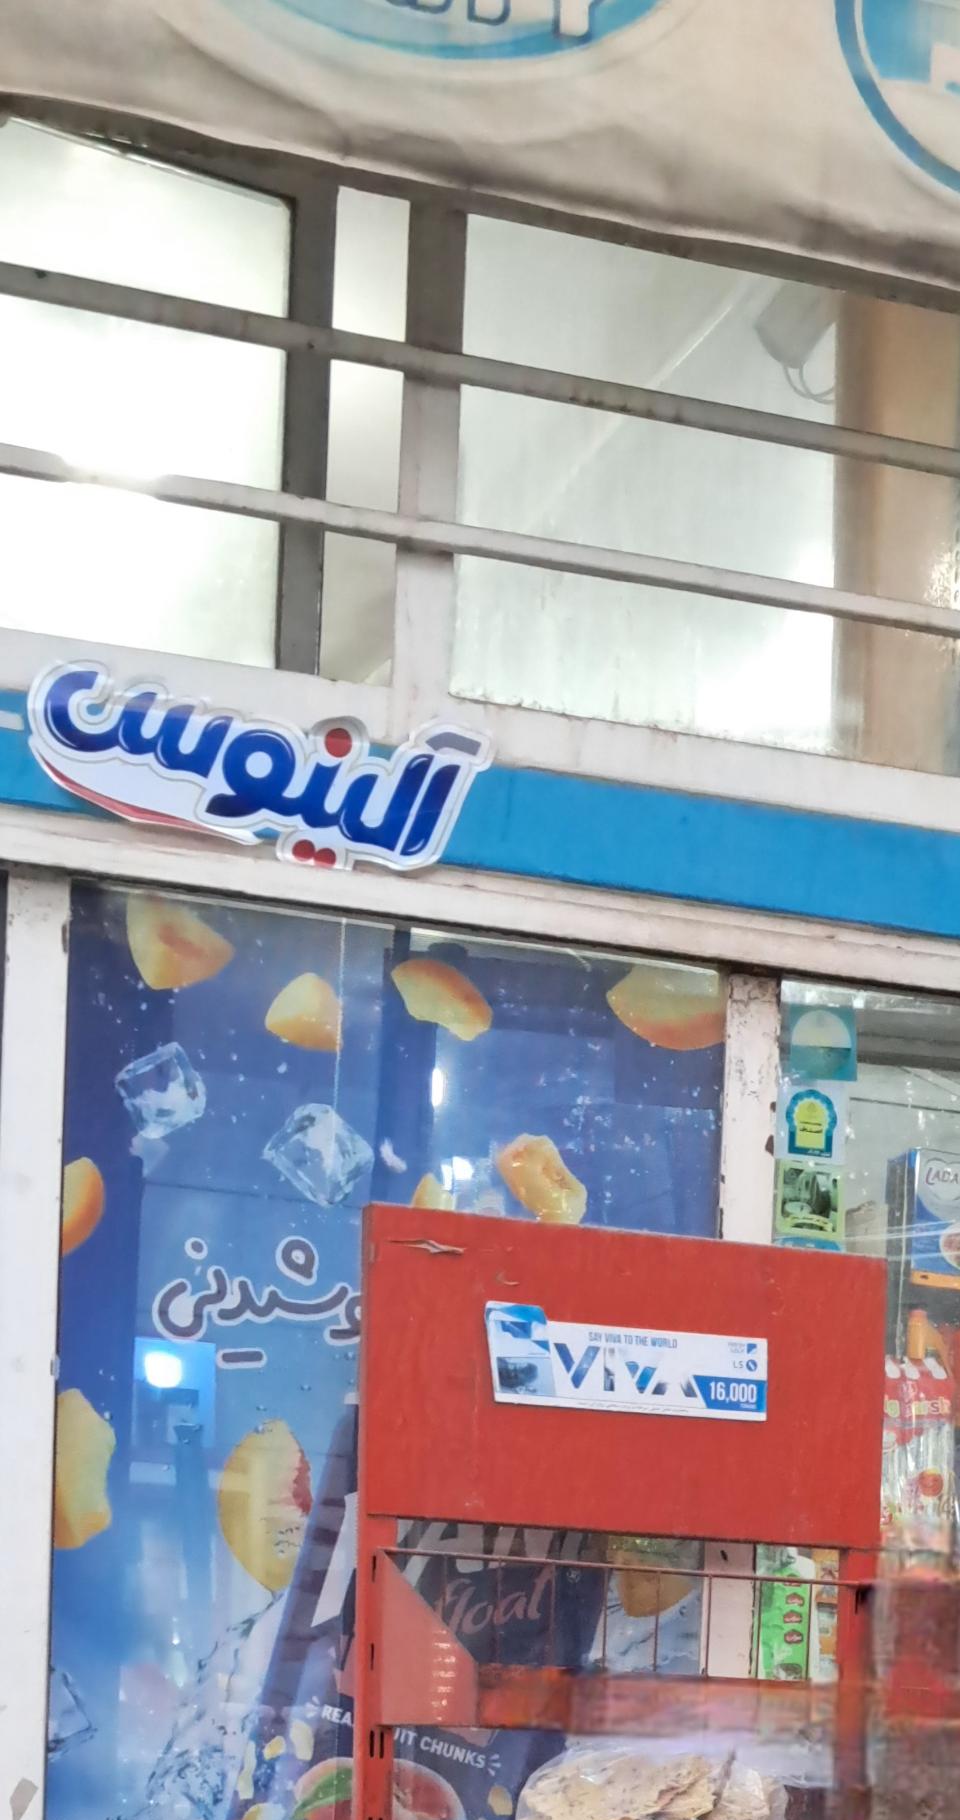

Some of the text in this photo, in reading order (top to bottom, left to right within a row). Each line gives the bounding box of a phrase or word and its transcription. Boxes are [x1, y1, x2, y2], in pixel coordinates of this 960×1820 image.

[588, 1331, 678, 1349] SAY VIVA TO THE WORLD
[709, 1380, 758, 1403] 16,000
[321, 1704, 355, 1727] REA
[420, 1735, 487, 1769] CHUNKS
